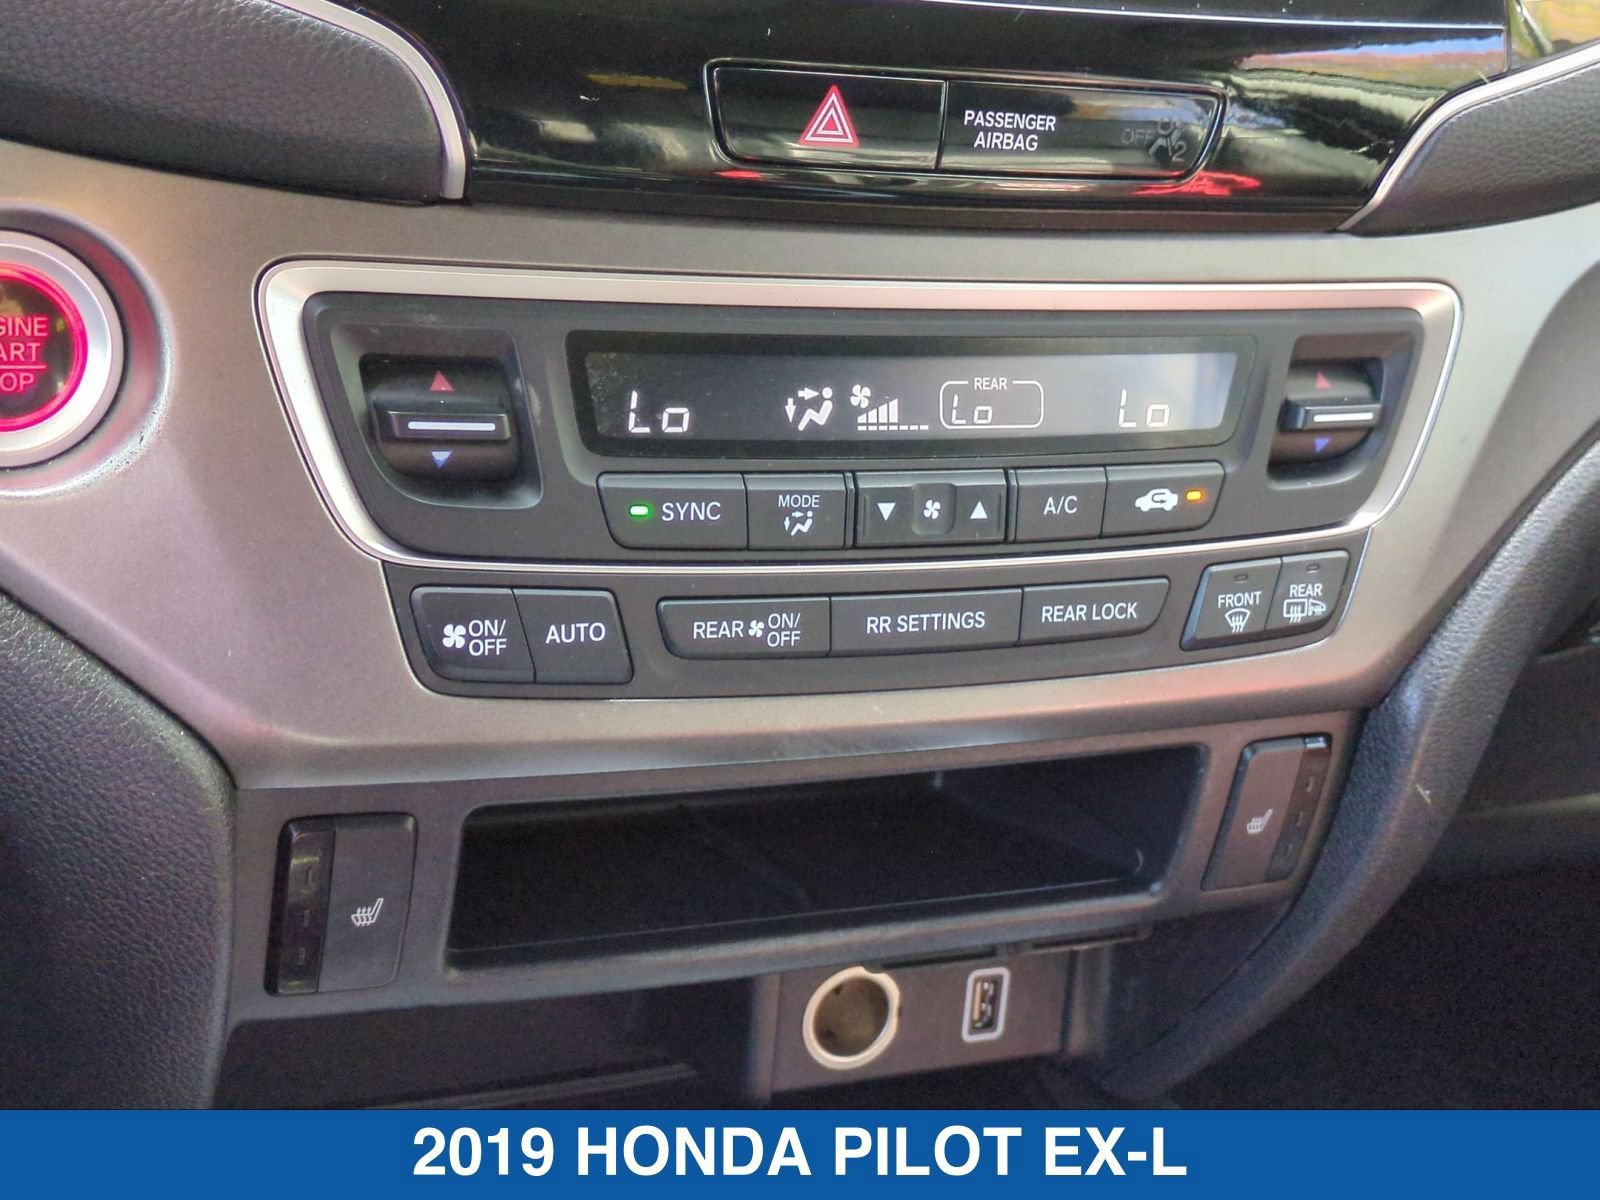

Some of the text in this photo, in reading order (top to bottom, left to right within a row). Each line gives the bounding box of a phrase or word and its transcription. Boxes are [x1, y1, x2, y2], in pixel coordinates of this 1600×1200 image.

[964, 109, 1056, 131] PASSENGER
[973, 131, 1039, 152] AIRBAG
[973, 377, 1008, 391] REAR
[778, 494, 820, 509] MODE
[1043, 495, 1078, 516] A/C
[661, 501, 721, 522] SYNC
[1217, 591, 1262, 608] FRONT
[1289, 583, 1324, 597] REAR
[767, 613, 801, 629] ON/
[1041, 602, 1138, 623] REAR LOCK
[468, 619, 507, 637] ON/
[693, 620, 744, 639] REAR
[866, 611, 986, 634] RR SETTINGS
[545, 622, 606, 644] AUTO
[767, 630, 801, 647] OFF
[468, 638, 508, 657] OFF
